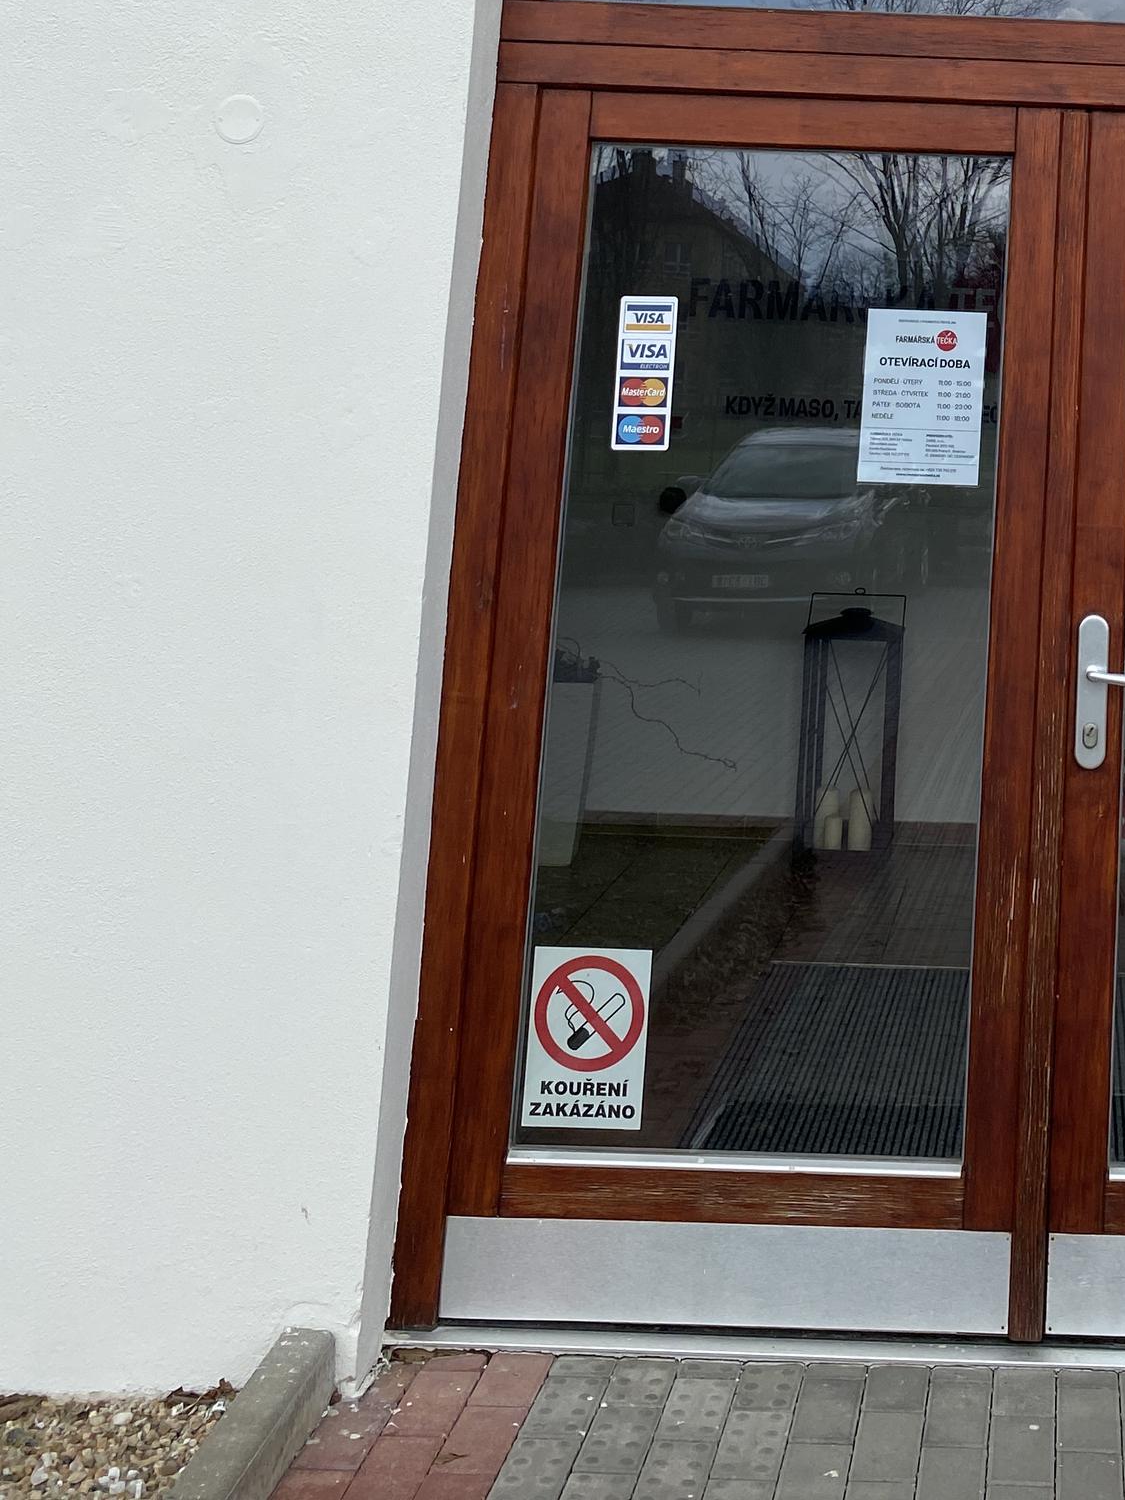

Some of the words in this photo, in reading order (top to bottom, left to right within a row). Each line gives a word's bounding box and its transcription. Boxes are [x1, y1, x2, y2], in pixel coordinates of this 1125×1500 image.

[633, 312, 666, 324] VISA
[627, 343, 668, 359] VISA
[879, 356, 938, 368] OTEVÍRACÍ
[940, 358, 971, 369] DOBA
[621, 386, 667, 398] MasterCard
[725, 393, 776, 418] KDYŽ
[777, 396, 839, 421] MASO,
[622, 424, 660, 435] Maestro
[540, 1077, 629, 1098] KOUŘENÍ
[529, 1100, 636, 1120] ZAKÁZÁNO
